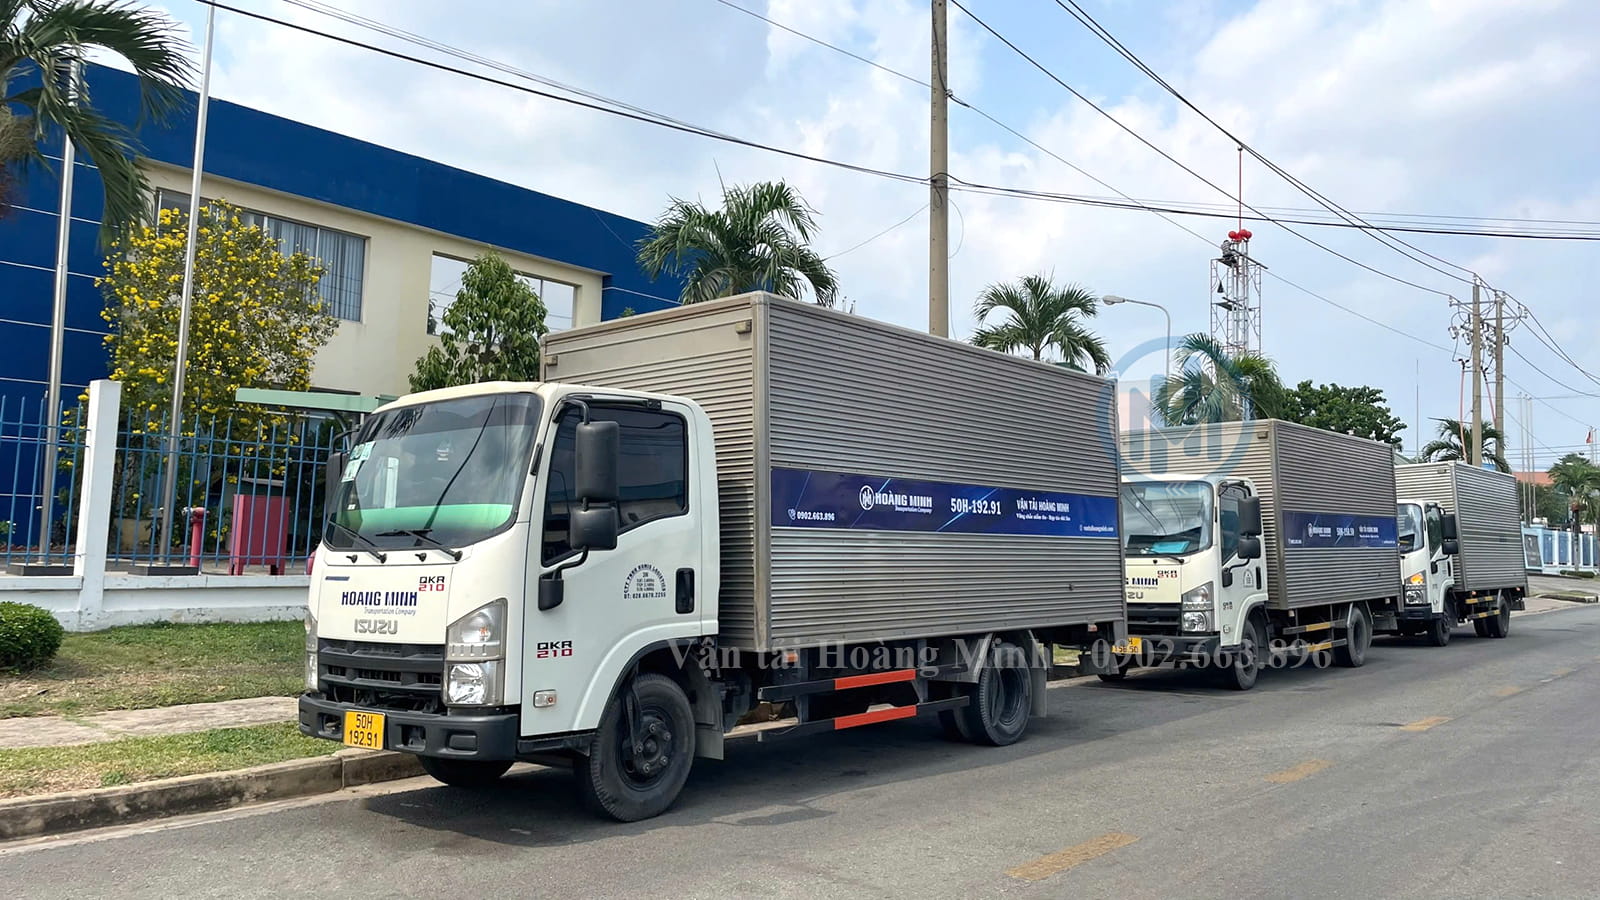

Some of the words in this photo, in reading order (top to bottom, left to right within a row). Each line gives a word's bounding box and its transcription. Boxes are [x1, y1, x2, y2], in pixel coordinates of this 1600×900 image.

[875, 490, 908, 506] HOÀNG
[909, 495, 933, 507] MINH
[950, 497, 1002, 515] 50H-192.91
[418, 583, 445, 592] 210
[419, 576, 445, 584] QKR
[384, 591, 418, 607] MINH
[395, 607, 417, 617] Company
[354, 618, 398, 635] ISUZU
[537, 640, 573, 650] QKR
[536, 648, 573, 659] 210
[355, 713, 373, 730] 50H
[349, 729, 378, 748] 192.91
